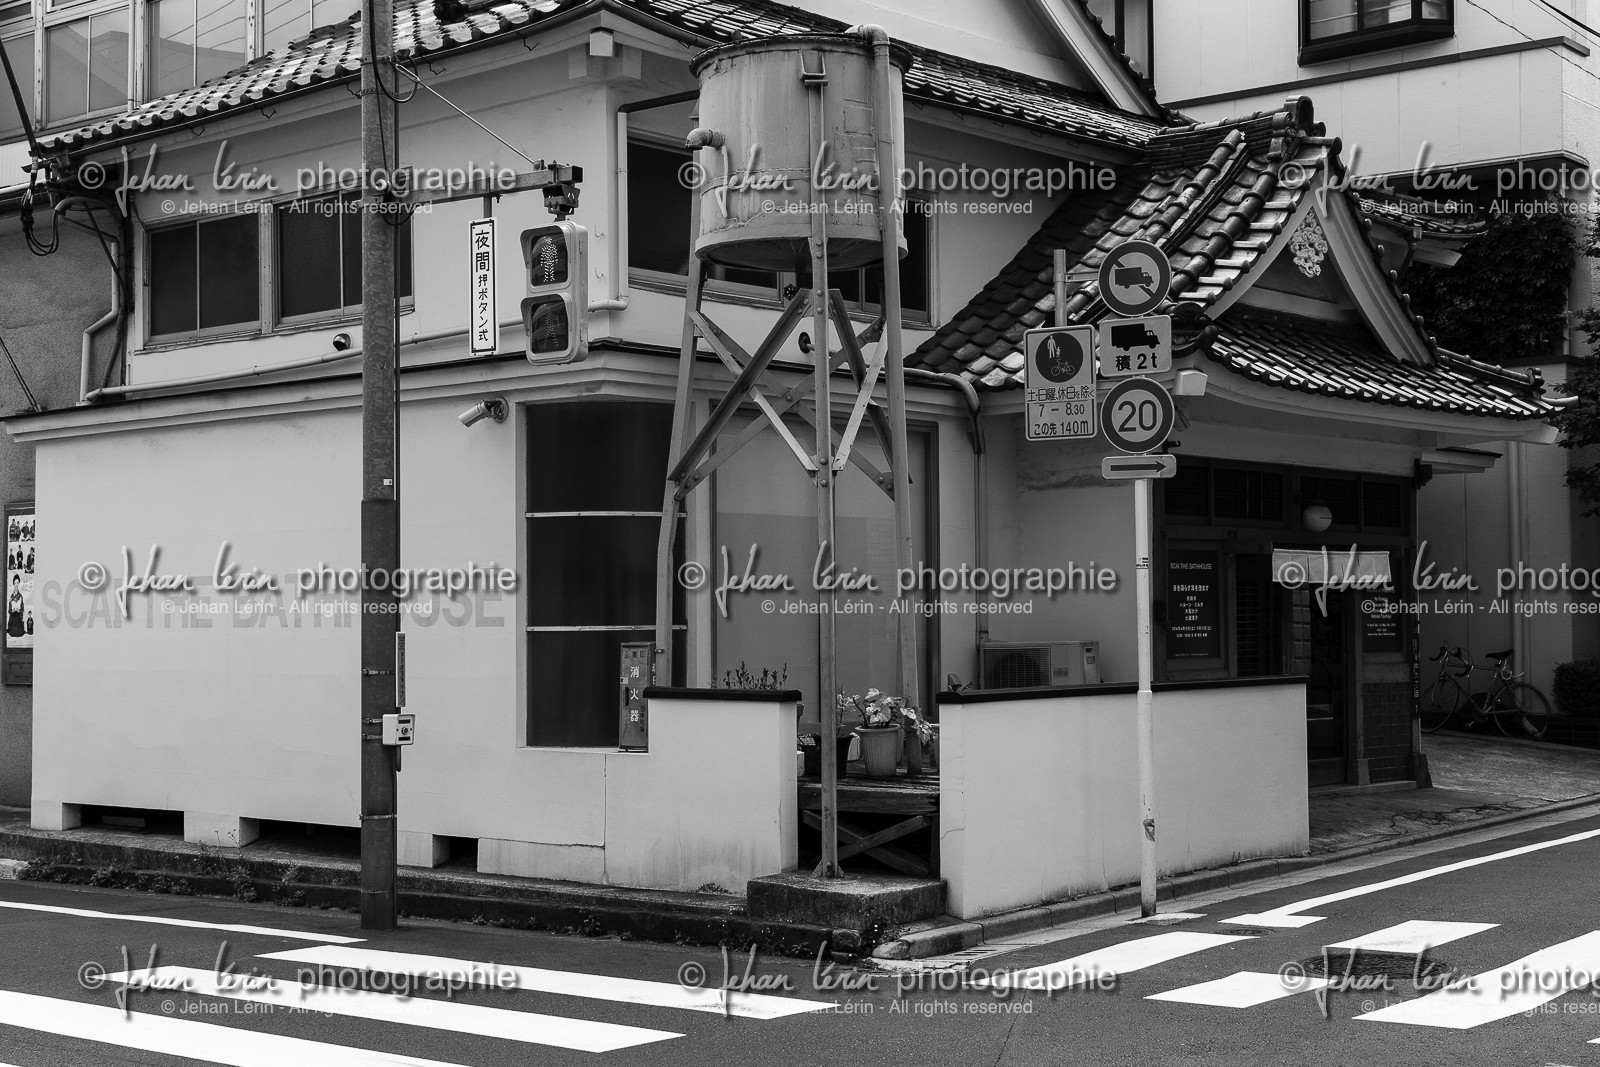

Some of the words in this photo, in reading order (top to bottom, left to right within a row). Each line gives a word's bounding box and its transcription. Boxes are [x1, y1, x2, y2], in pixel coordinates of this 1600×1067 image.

[475, 230, 490, 341] 夜間押ボタン式
[1039, 404, 1045, 417] 7
[1066, 402, 1085, 416] 8.30
[1118, 400, 1157, 432] 20
[41, 576, 123, 629] SCAI
[139, 575, 213, 629] THE
[630, 666, 640, 722] 消火器
